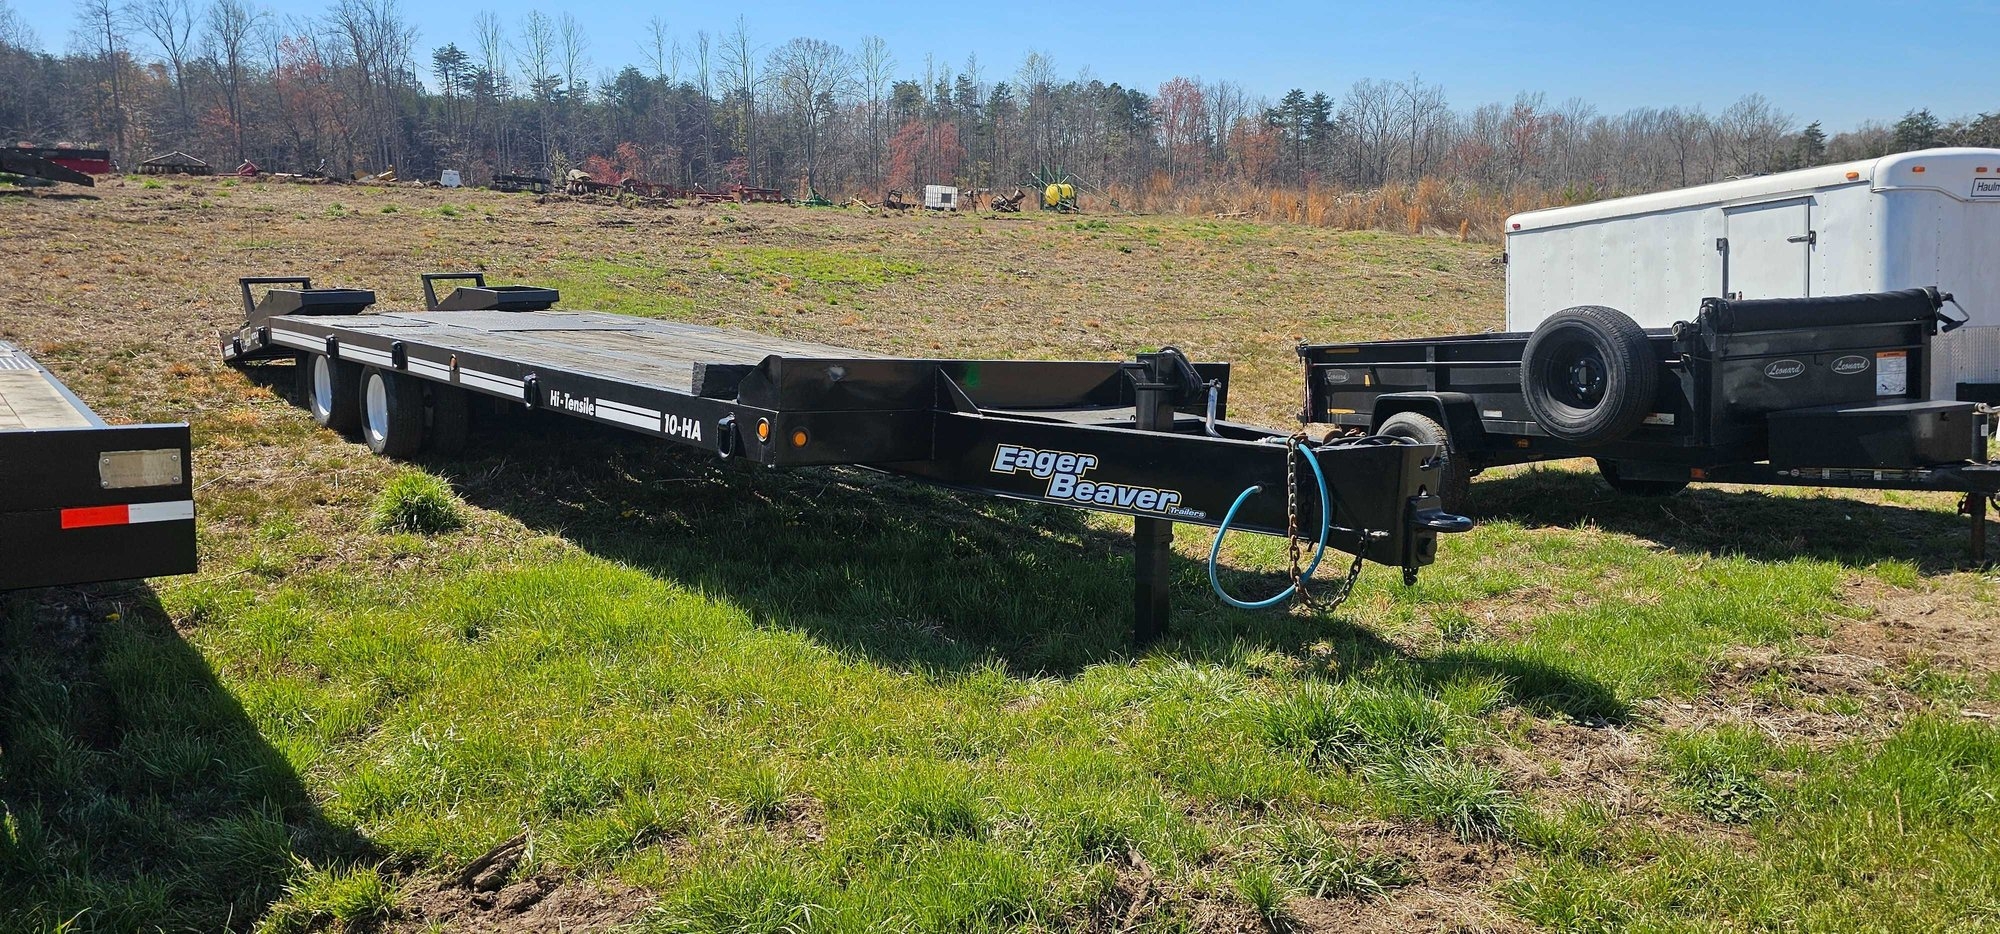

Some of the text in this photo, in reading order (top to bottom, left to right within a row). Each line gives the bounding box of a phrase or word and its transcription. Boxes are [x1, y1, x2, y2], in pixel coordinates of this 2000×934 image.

[1768, 364, 1801, 376] Leonard
[1834, 359, 1866, 371] Leonard
[664, 413, 702, 441] 10-HA
[993, 445, 1097, 478] Eager
[1047, 472, 1181, 512] Beaver
[1169, 506, 1205, 518] Trailers
